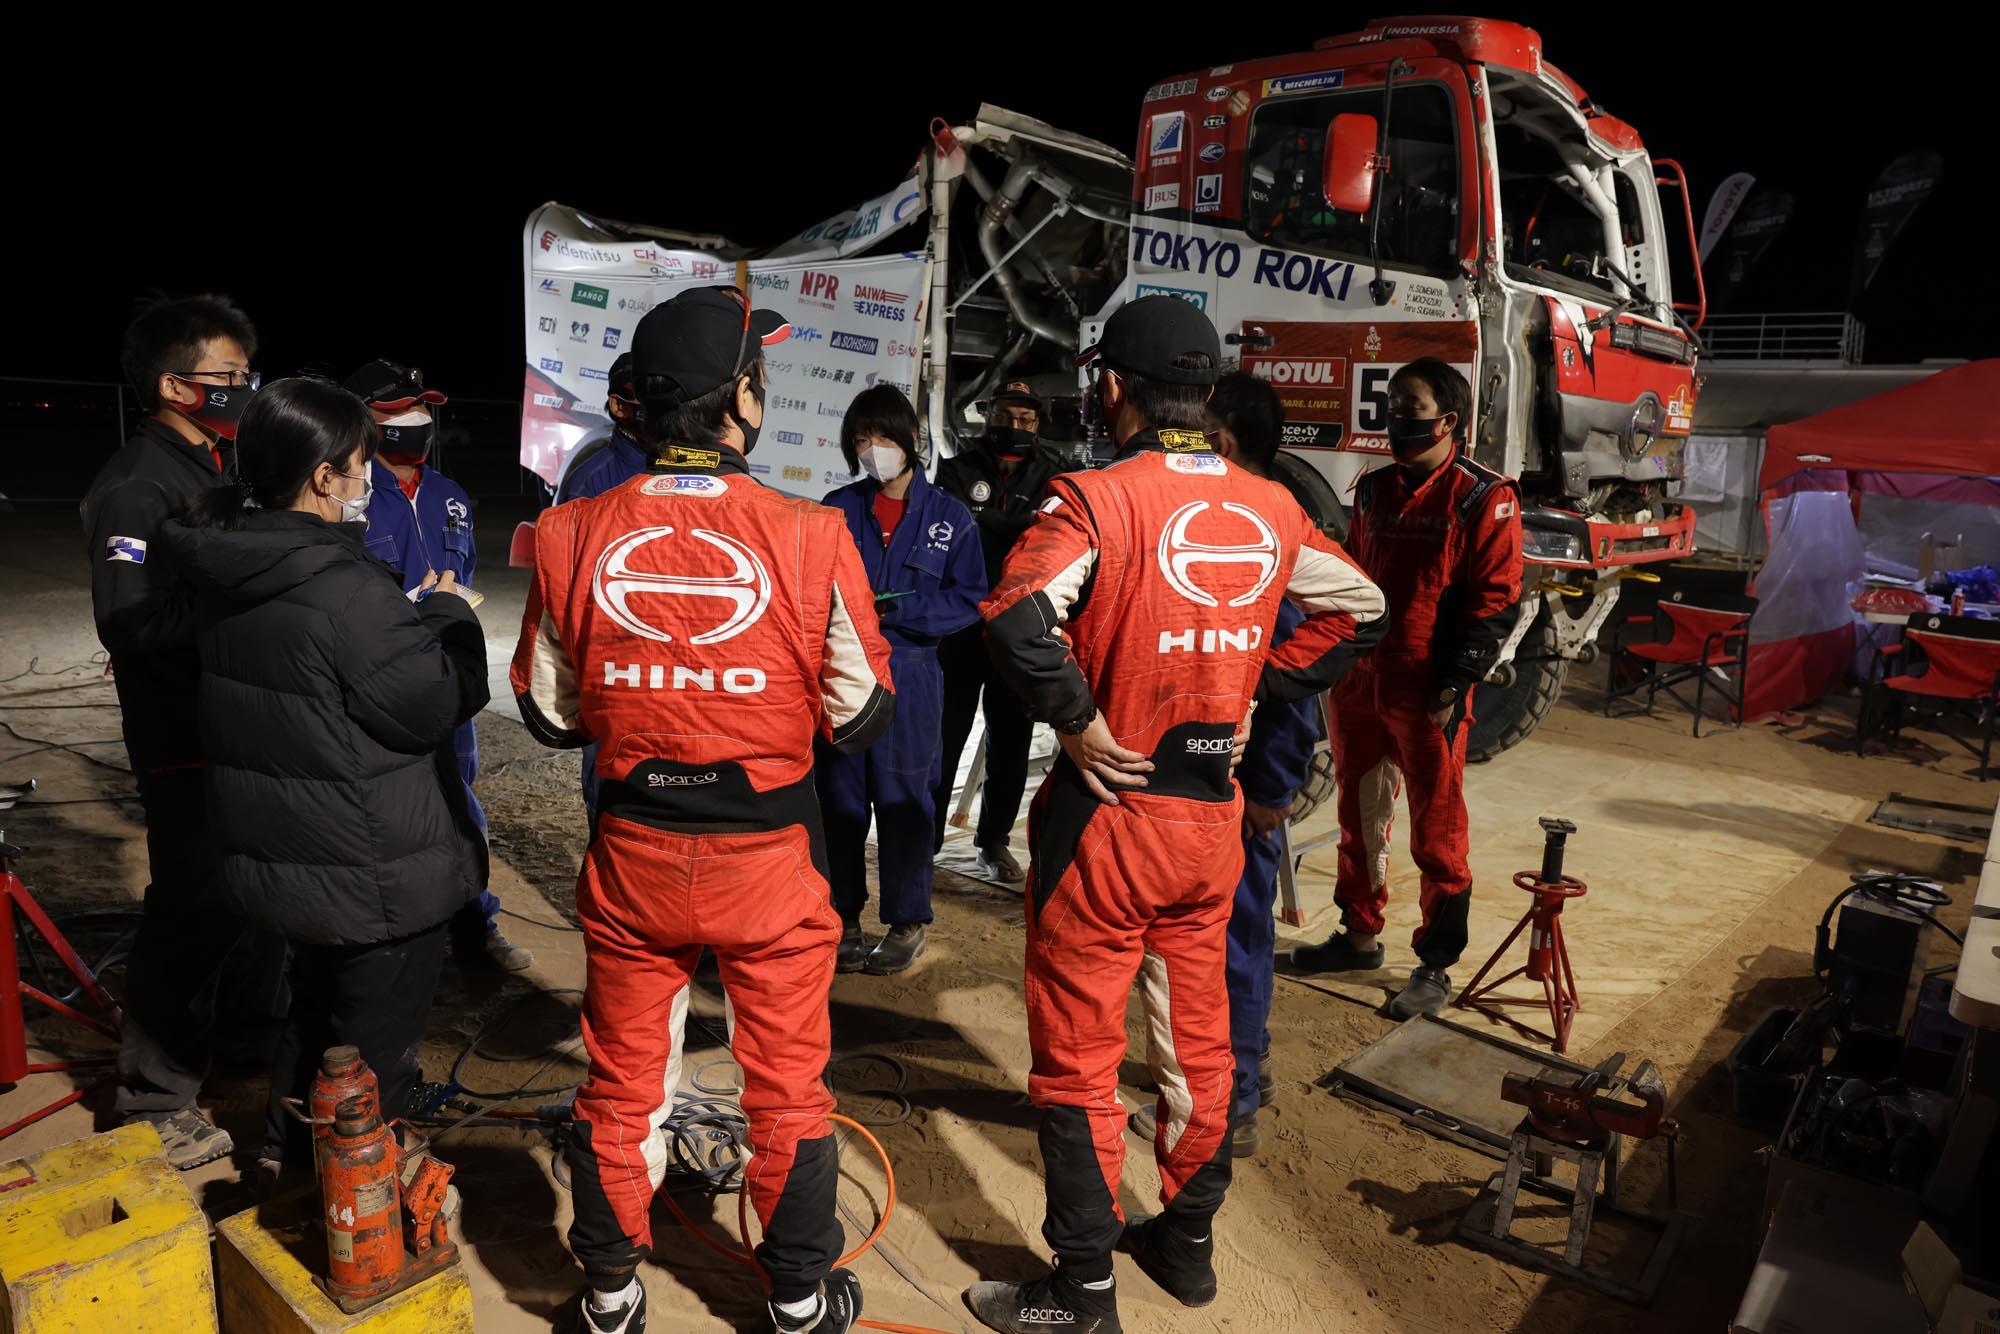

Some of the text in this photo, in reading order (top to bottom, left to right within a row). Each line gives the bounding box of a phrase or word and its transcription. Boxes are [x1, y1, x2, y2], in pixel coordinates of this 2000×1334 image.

[1387, 25, 1460, 35] INDONESIA
[1283, 77, 1336, 90] MICHELIN
[556, 238, 621, 263] idemitsu
[1132, 226, 1241, 278] TOKYO
[1253, 248, 1355, 301] ROKI
[800, 271, 839, 301] NPR
[854, 285, 887, 304] DAIWA
[577, 290, 604, 303] SANGO
[857, 301, 905, 322] EXPRESS
[840, 335, 878, 354] SOHSHIN
[1252, 361, 1335, 385] MOTUL
[1359, 368, 1390, 431] 5
[604, 661, 767, 694] HINO
[647, 772, 720, 787] sparco
[1018, 1307, 1076, 1325] sparco
